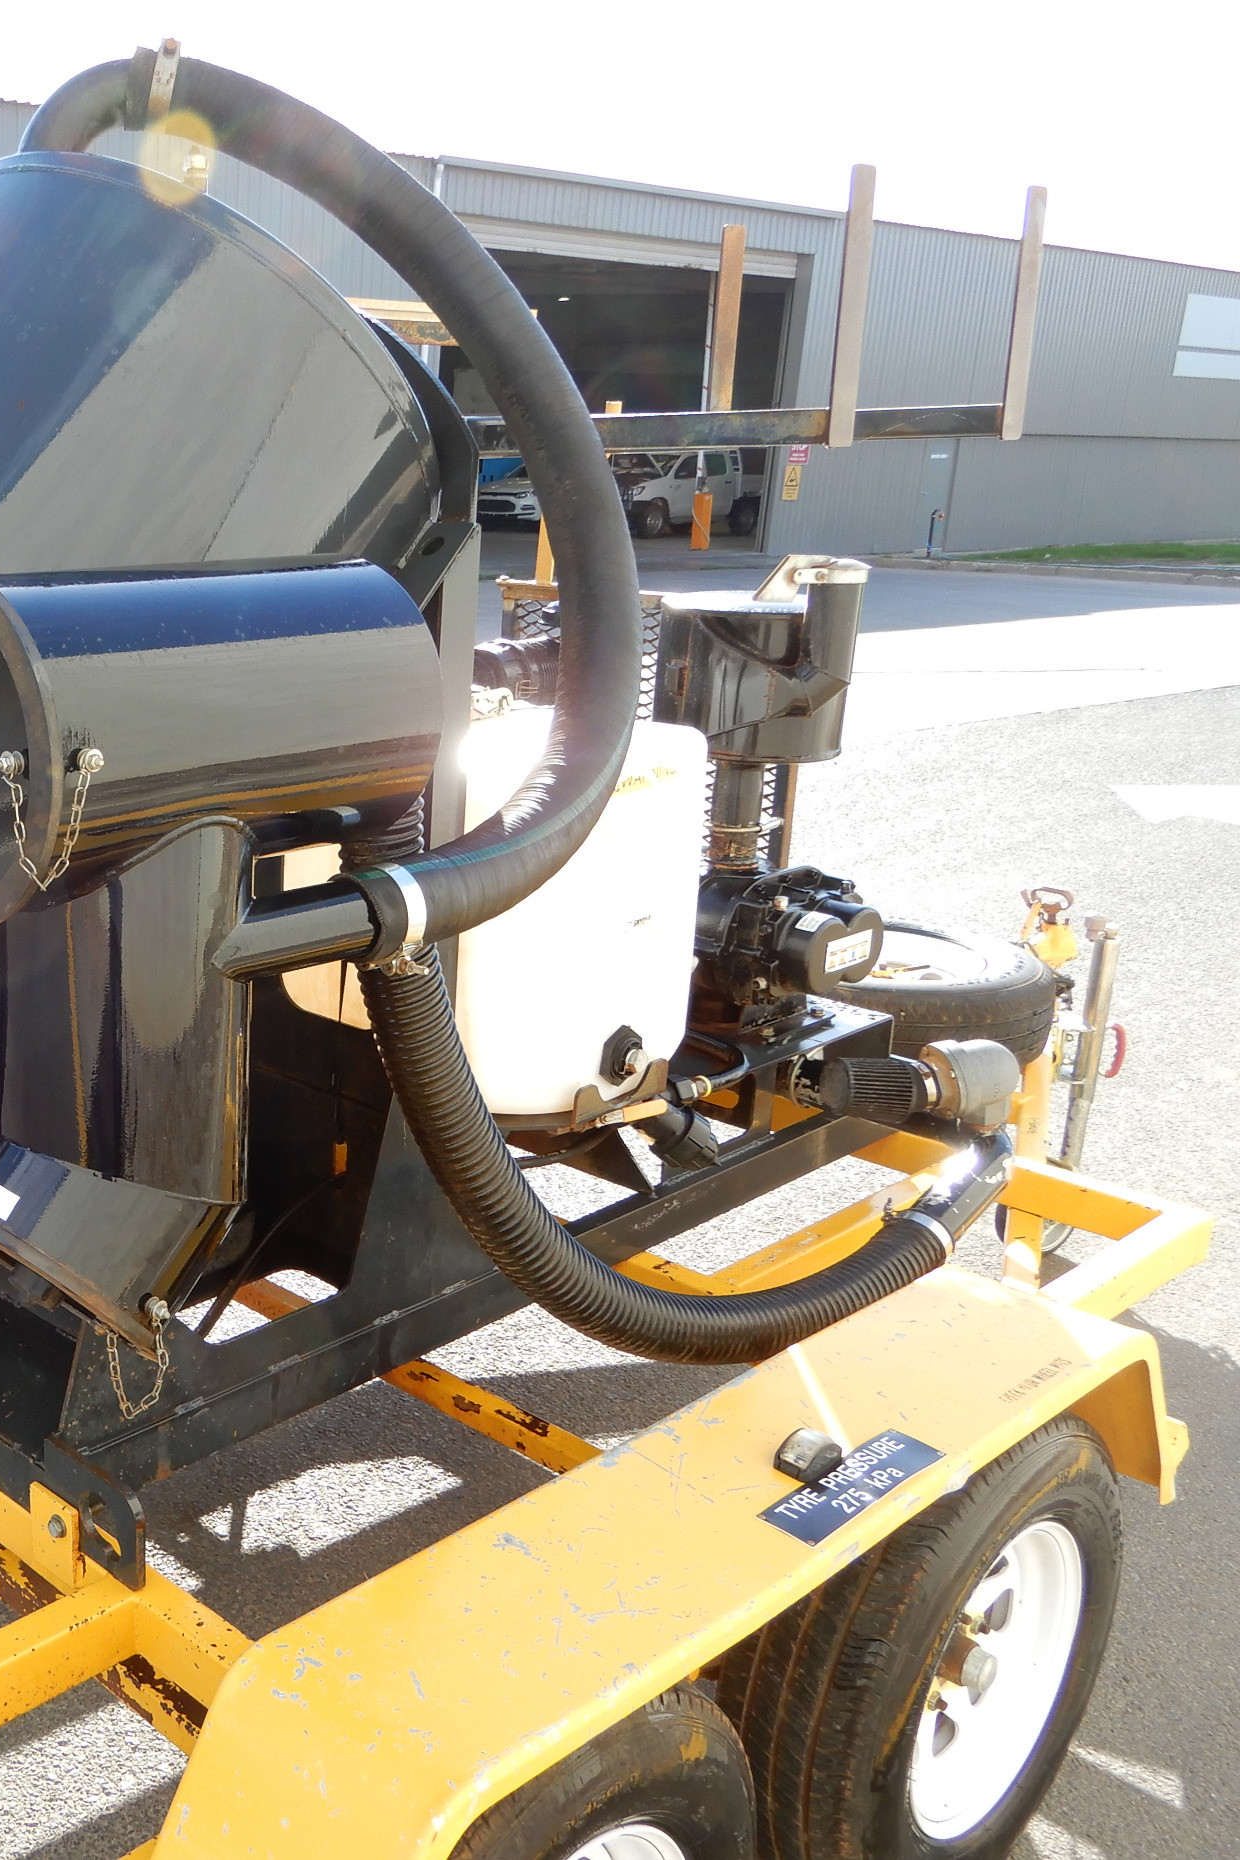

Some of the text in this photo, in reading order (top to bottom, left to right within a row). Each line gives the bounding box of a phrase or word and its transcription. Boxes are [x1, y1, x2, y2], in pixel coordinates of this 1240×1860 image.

[774, 1436, 907, 1520] TYRE PRESSURE
[831, 1467, 906, 1515] 275 kPa
